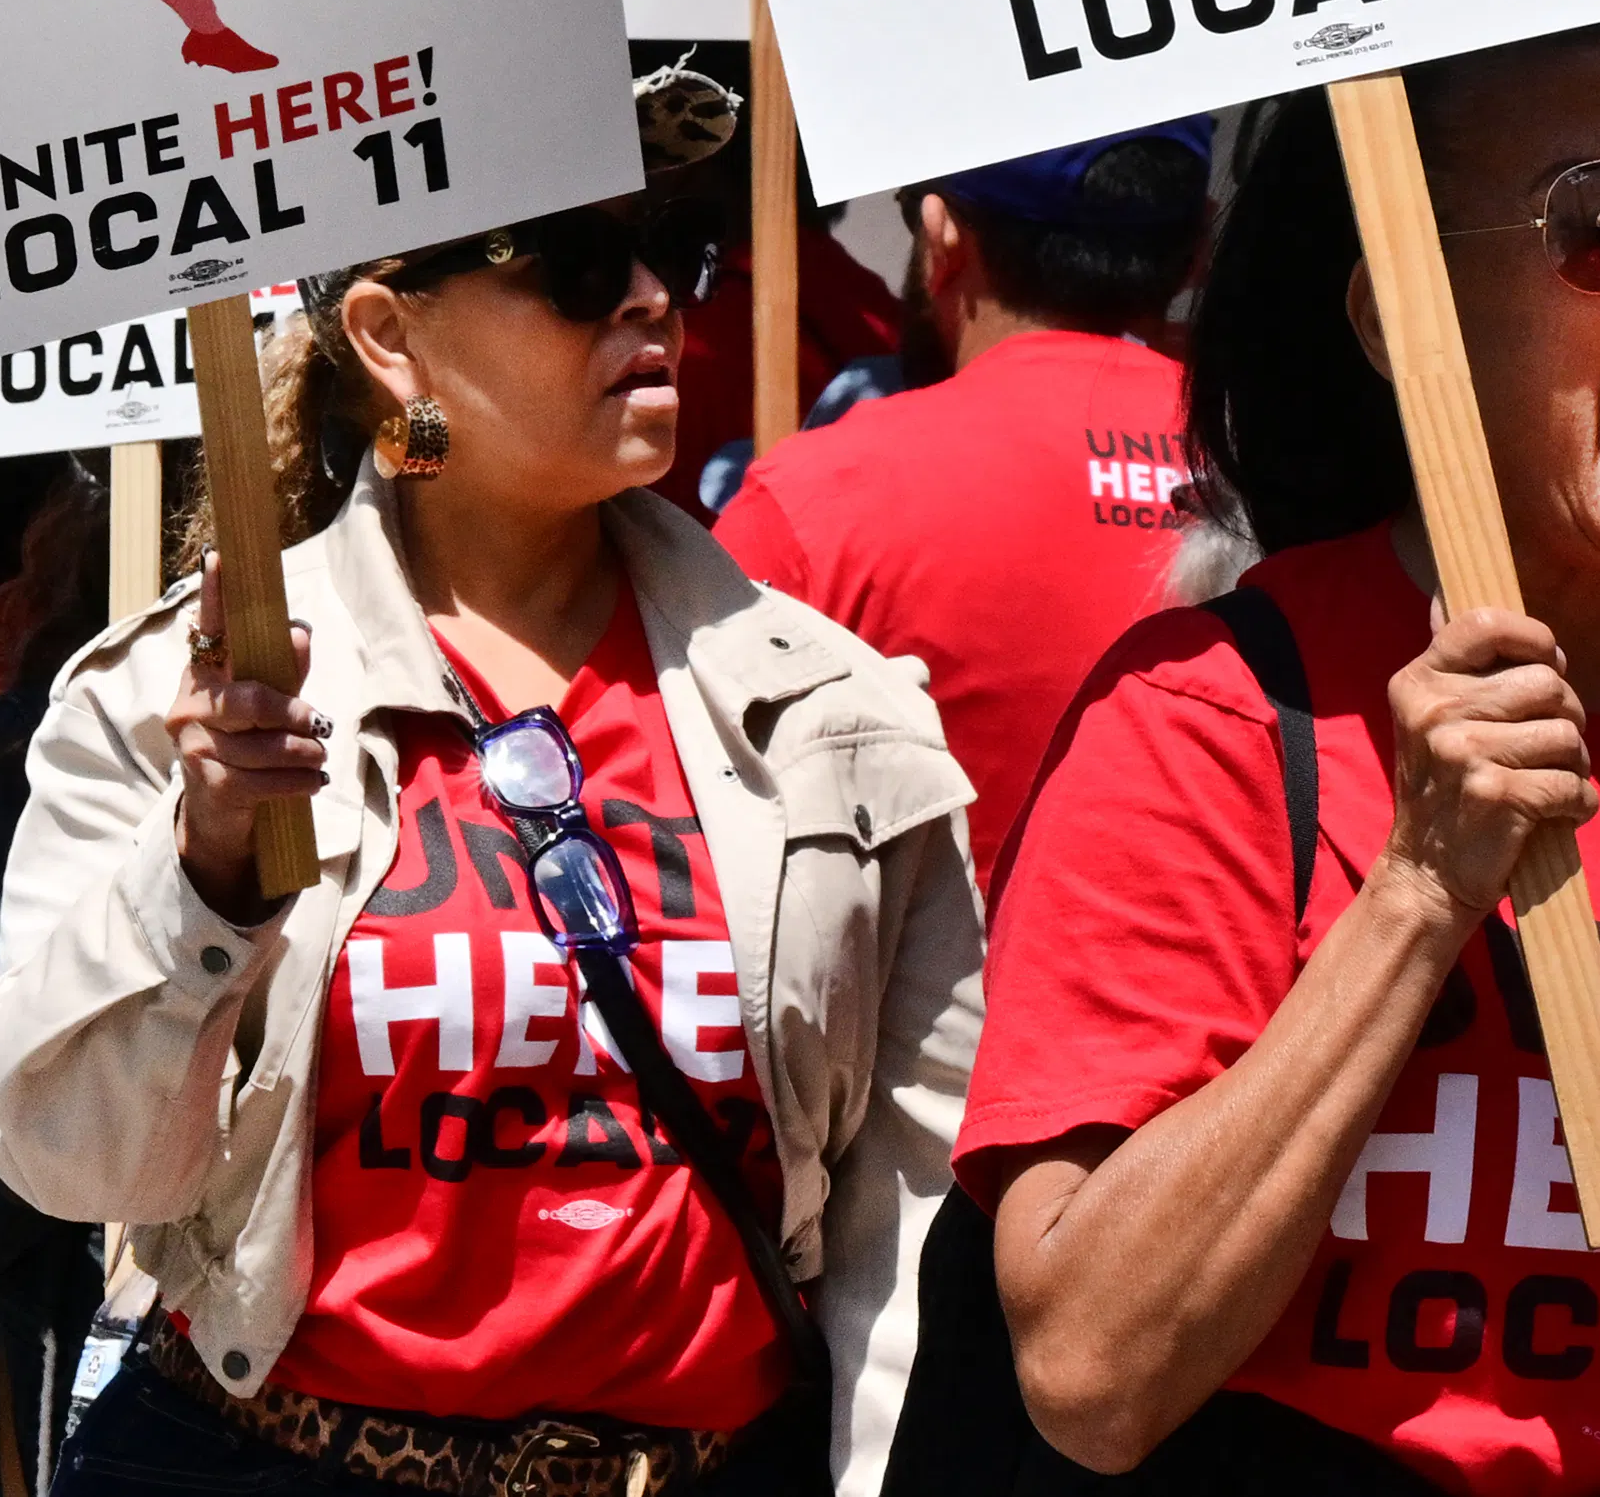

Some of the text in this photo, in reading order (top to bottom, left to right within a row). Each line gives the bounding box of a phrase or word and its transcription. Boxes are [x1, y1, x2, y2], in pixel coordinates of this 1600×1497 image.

[216, 47, 436, 159] HERE!
[353, 117, 449, 205] 11
[1085, 429, 1185, 463] UNI
[1088, 460, 1193, 503] HER
